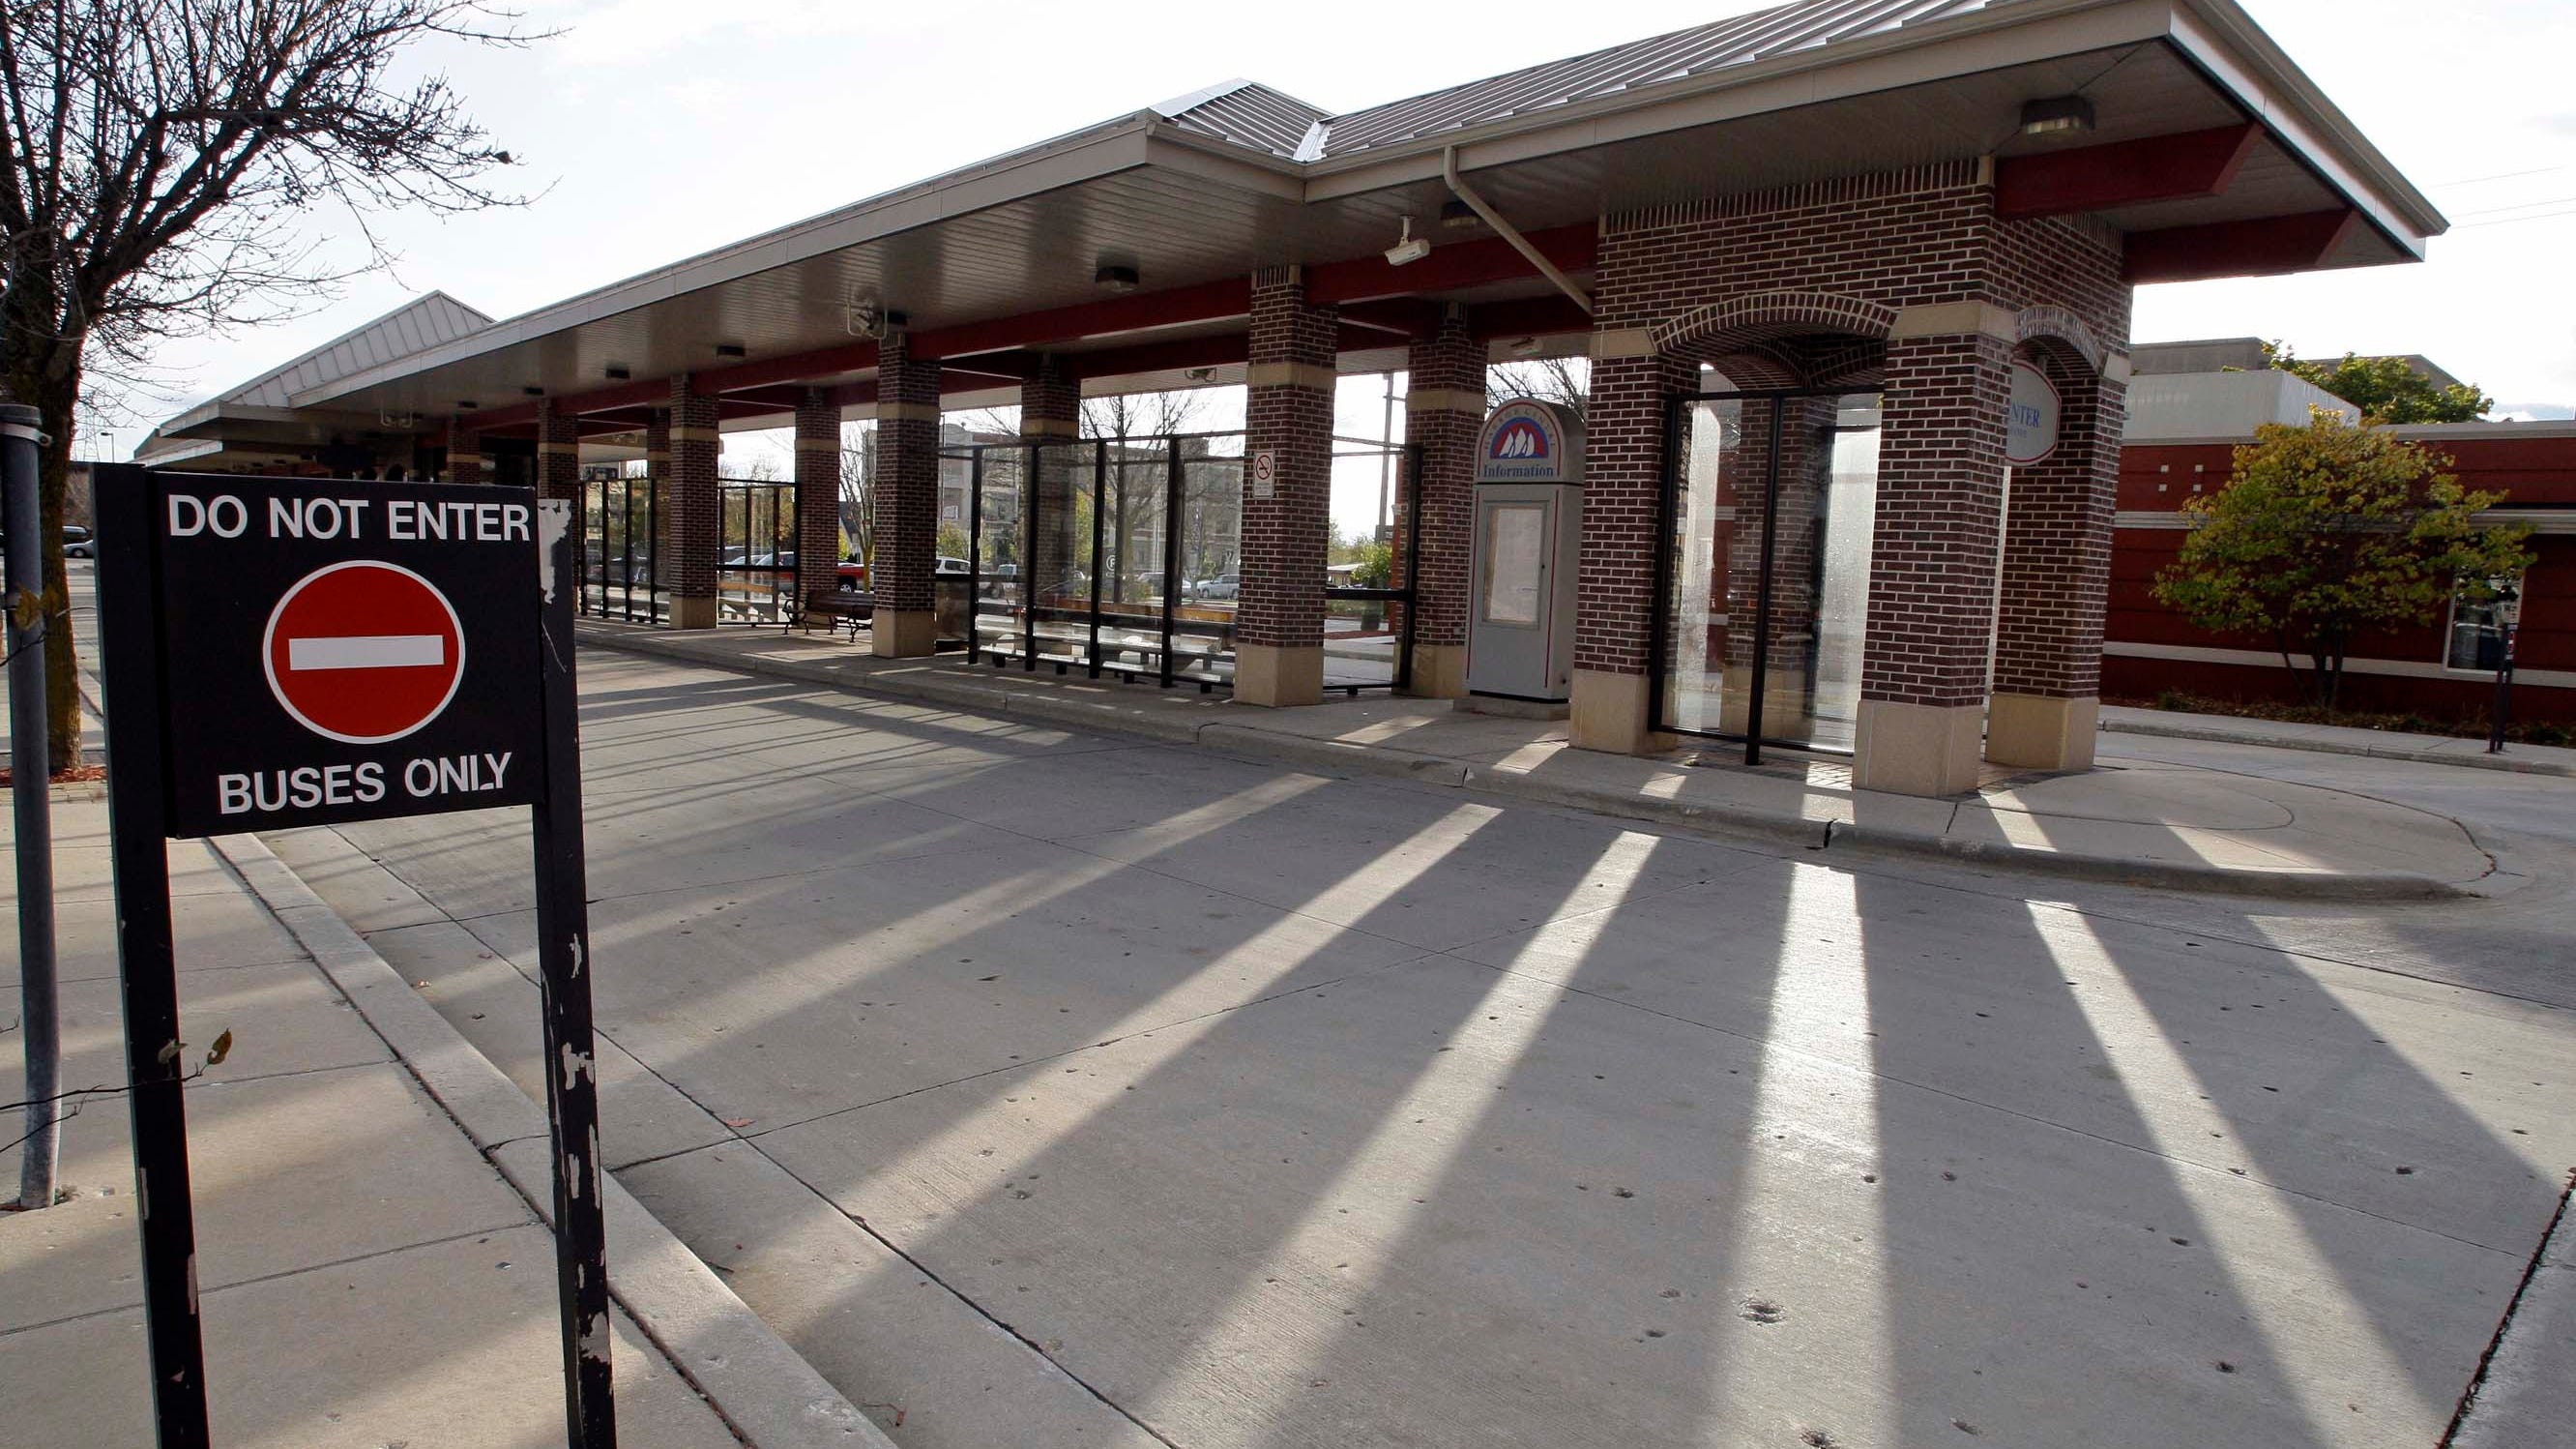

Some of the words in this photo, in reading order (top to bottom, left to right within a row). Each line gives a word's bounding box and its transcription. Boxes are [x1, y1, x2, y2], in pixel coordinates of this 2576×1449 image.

[1483, 464, 1554, 478] Information
[169, 495, 248, 538] DO
[270, 498, 368, 539] NOT
[389, 501, 529, 541] ENTER
[220, 762, 385, 813] BUSES
[405, 753, 512, 796] ONLY
